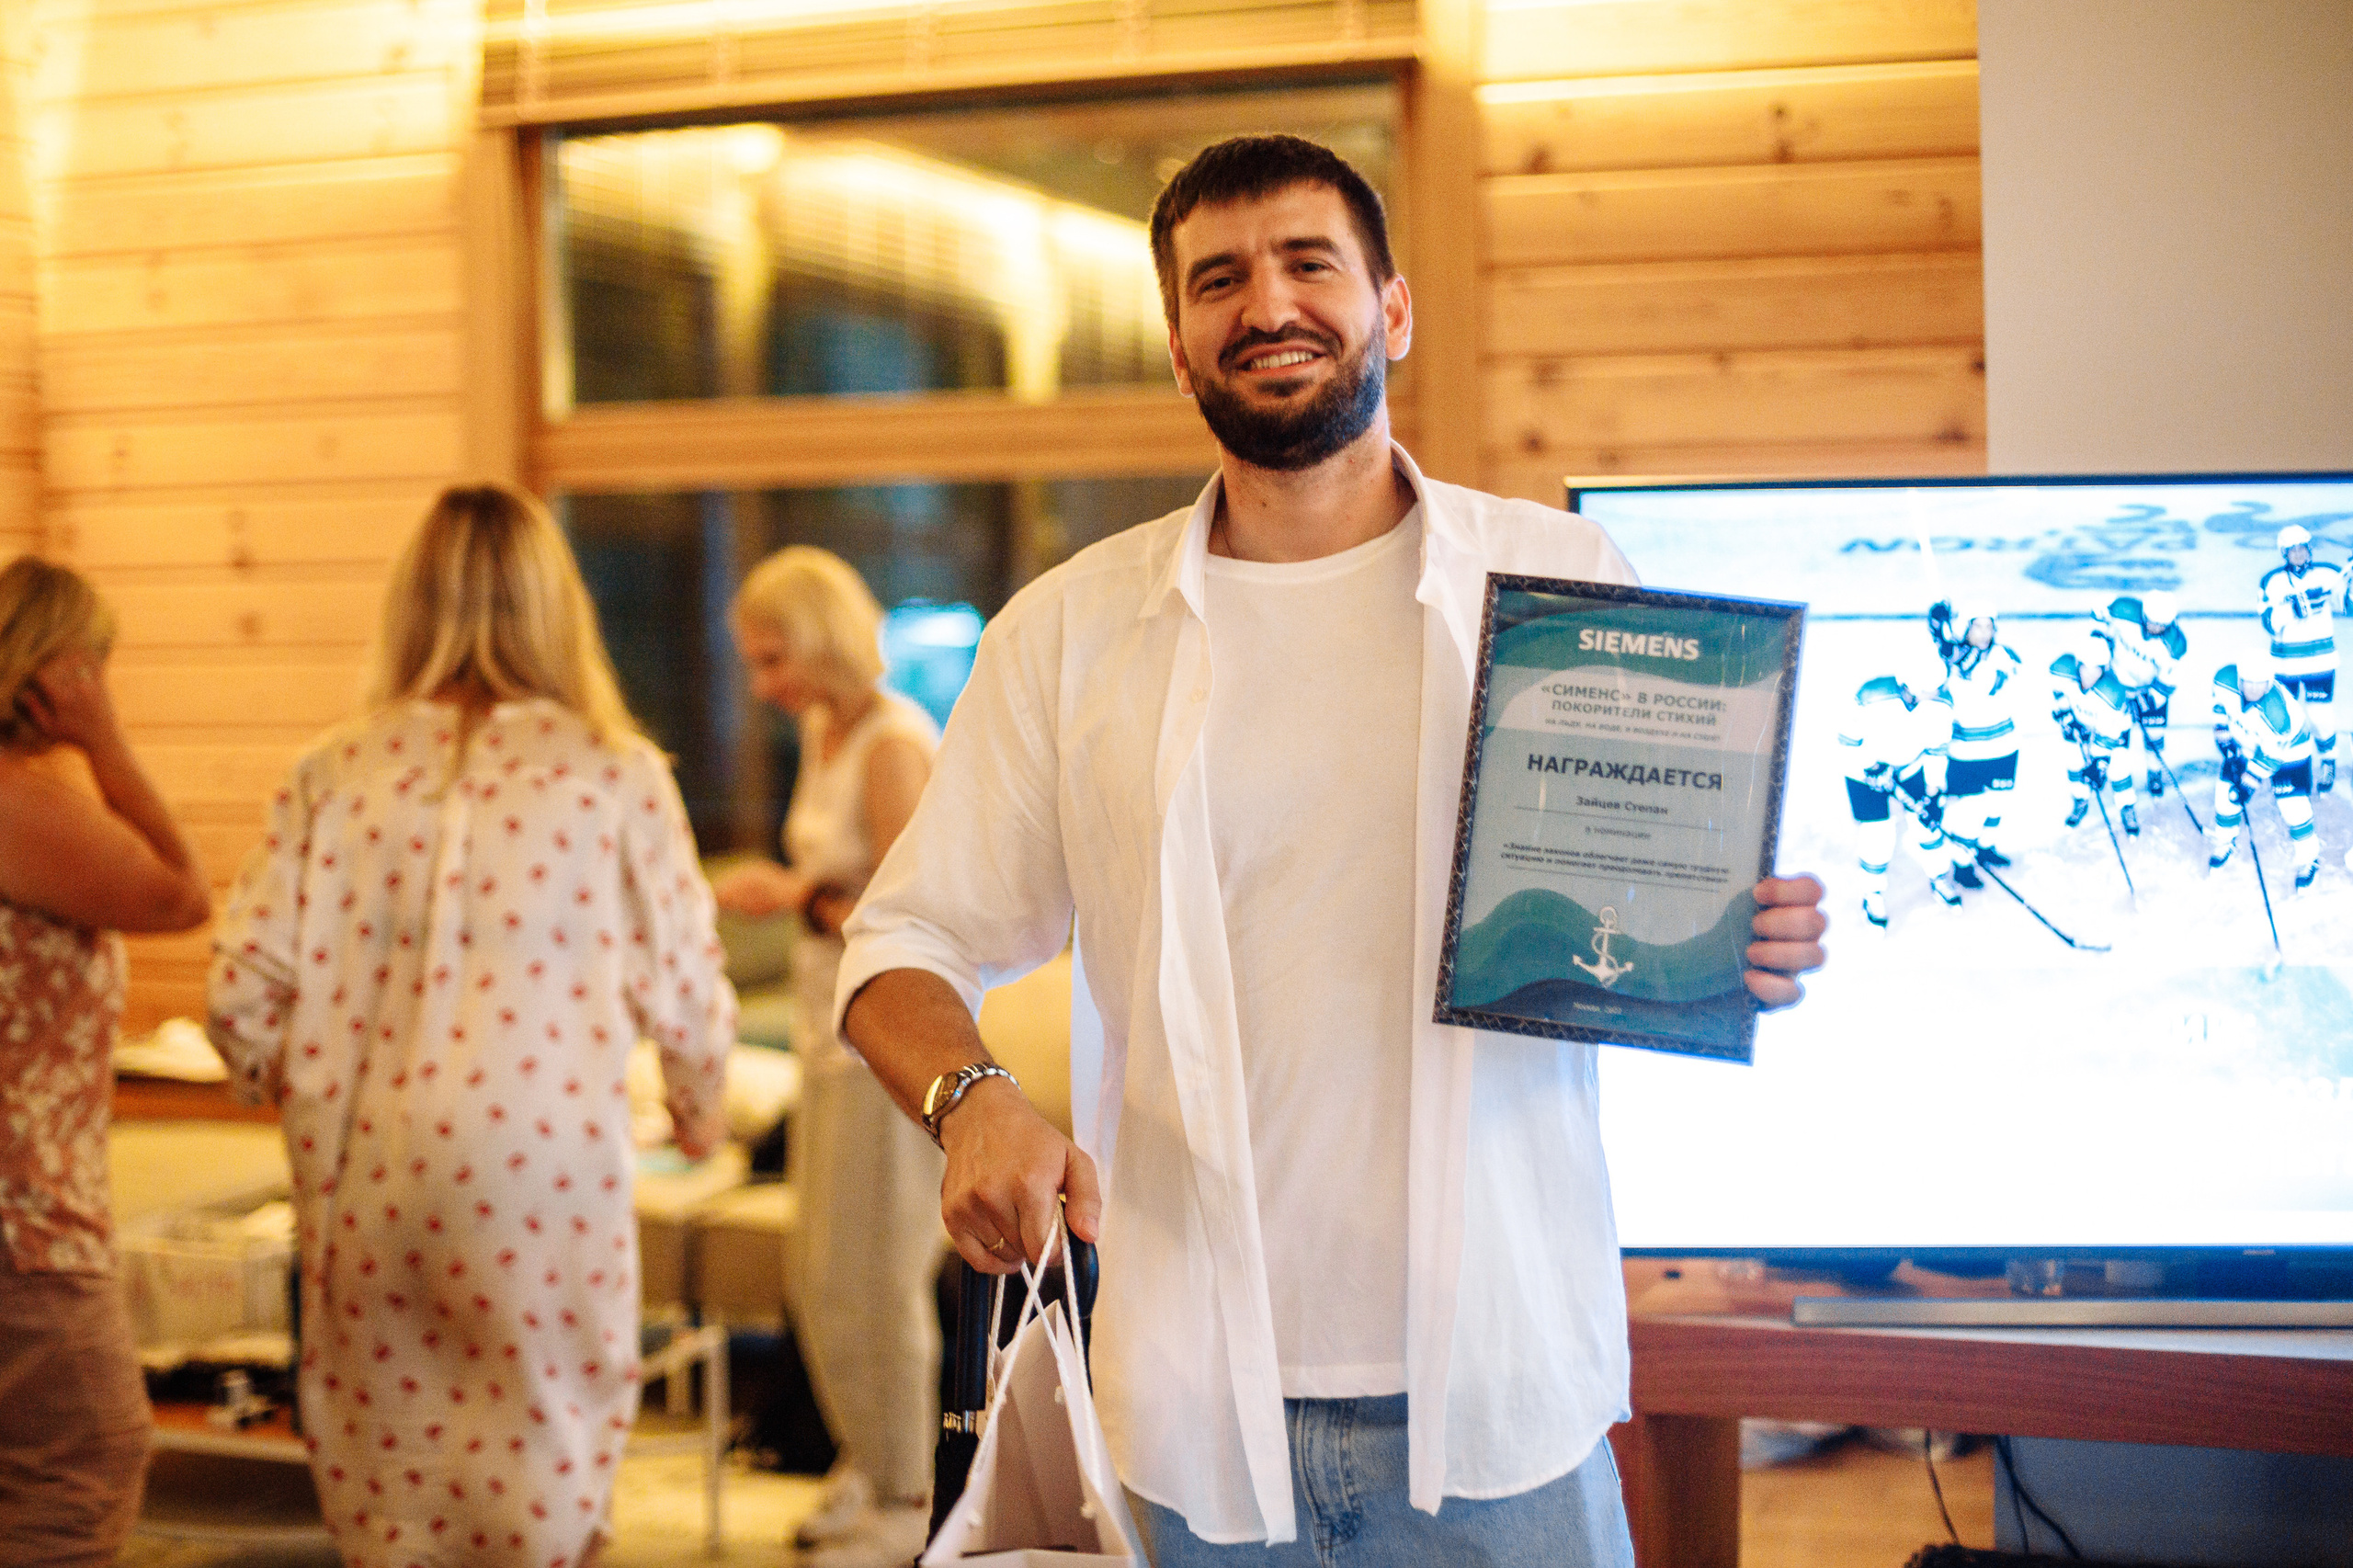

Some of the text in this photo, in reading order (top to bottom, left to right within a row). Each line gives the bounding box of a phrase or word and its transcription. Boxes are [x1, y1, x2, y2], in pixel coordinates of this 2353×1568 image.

[1578, 629, 1700, 661] SIEMENS
[1540, 683, 1727, 712] «СИМЕНС» В РОССИИ:
[1552, 699, 1717, 726] ПОКОРИТЕЛИ СТИХИЙ
[1528, 754, 1722, 790] НАГРАЖДАЕТСЯ
[1575, 795, 1668, 815] Зайцев Степан
